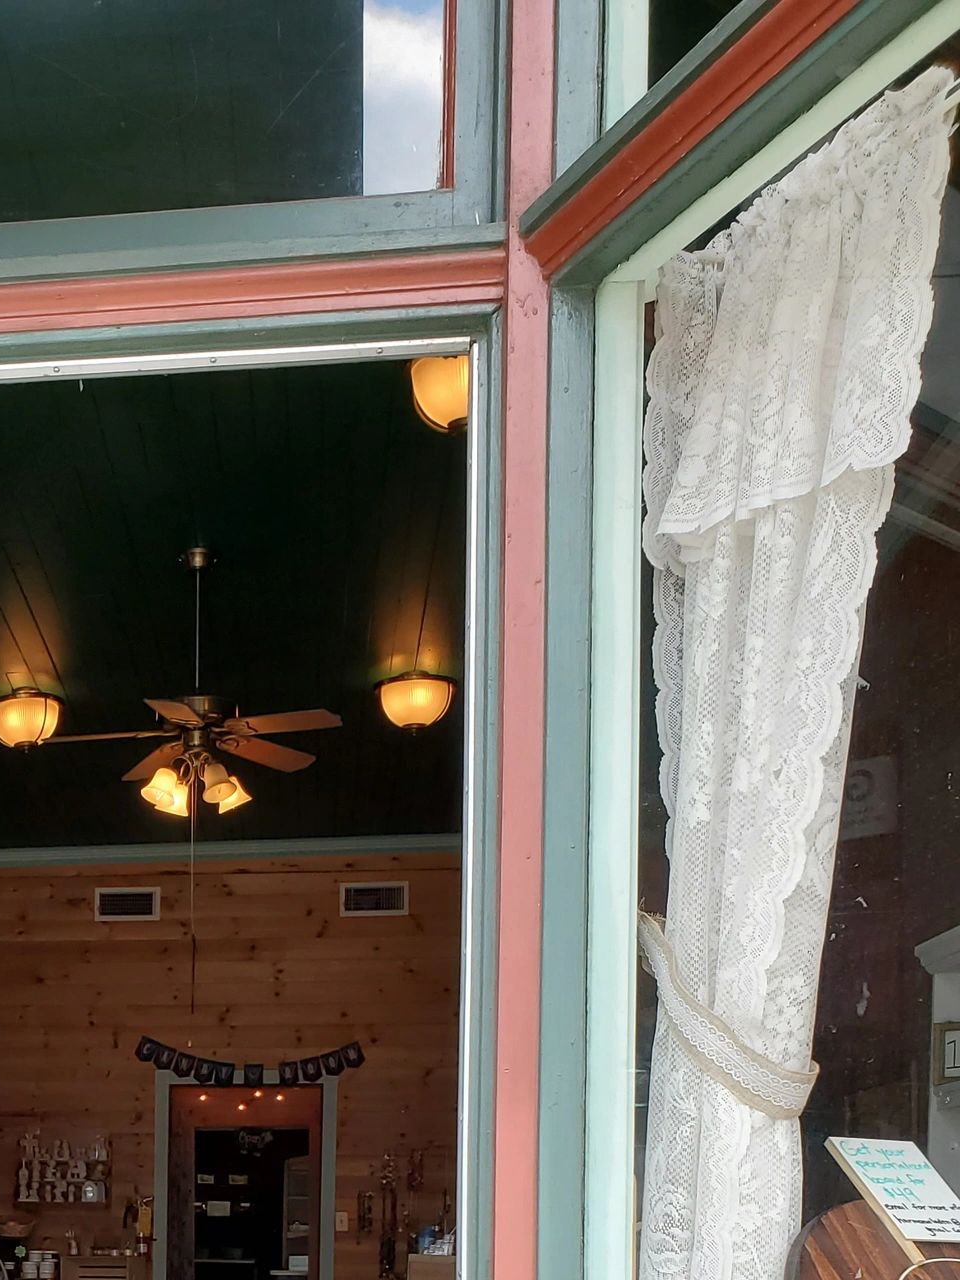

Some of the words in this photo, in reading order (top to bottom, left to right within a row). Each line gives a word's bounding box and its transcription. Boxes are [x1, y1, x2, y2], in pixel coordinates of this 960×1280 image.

[840, 1141, 871, 1156] Get
[875, 1148, 905, 1161] your
[862, 1172, 904, 1185] board
[906, 1174, 926, 1185] for
[882, 1187, 922, 1202] $49
[884, 1202, 909, 1210] email
